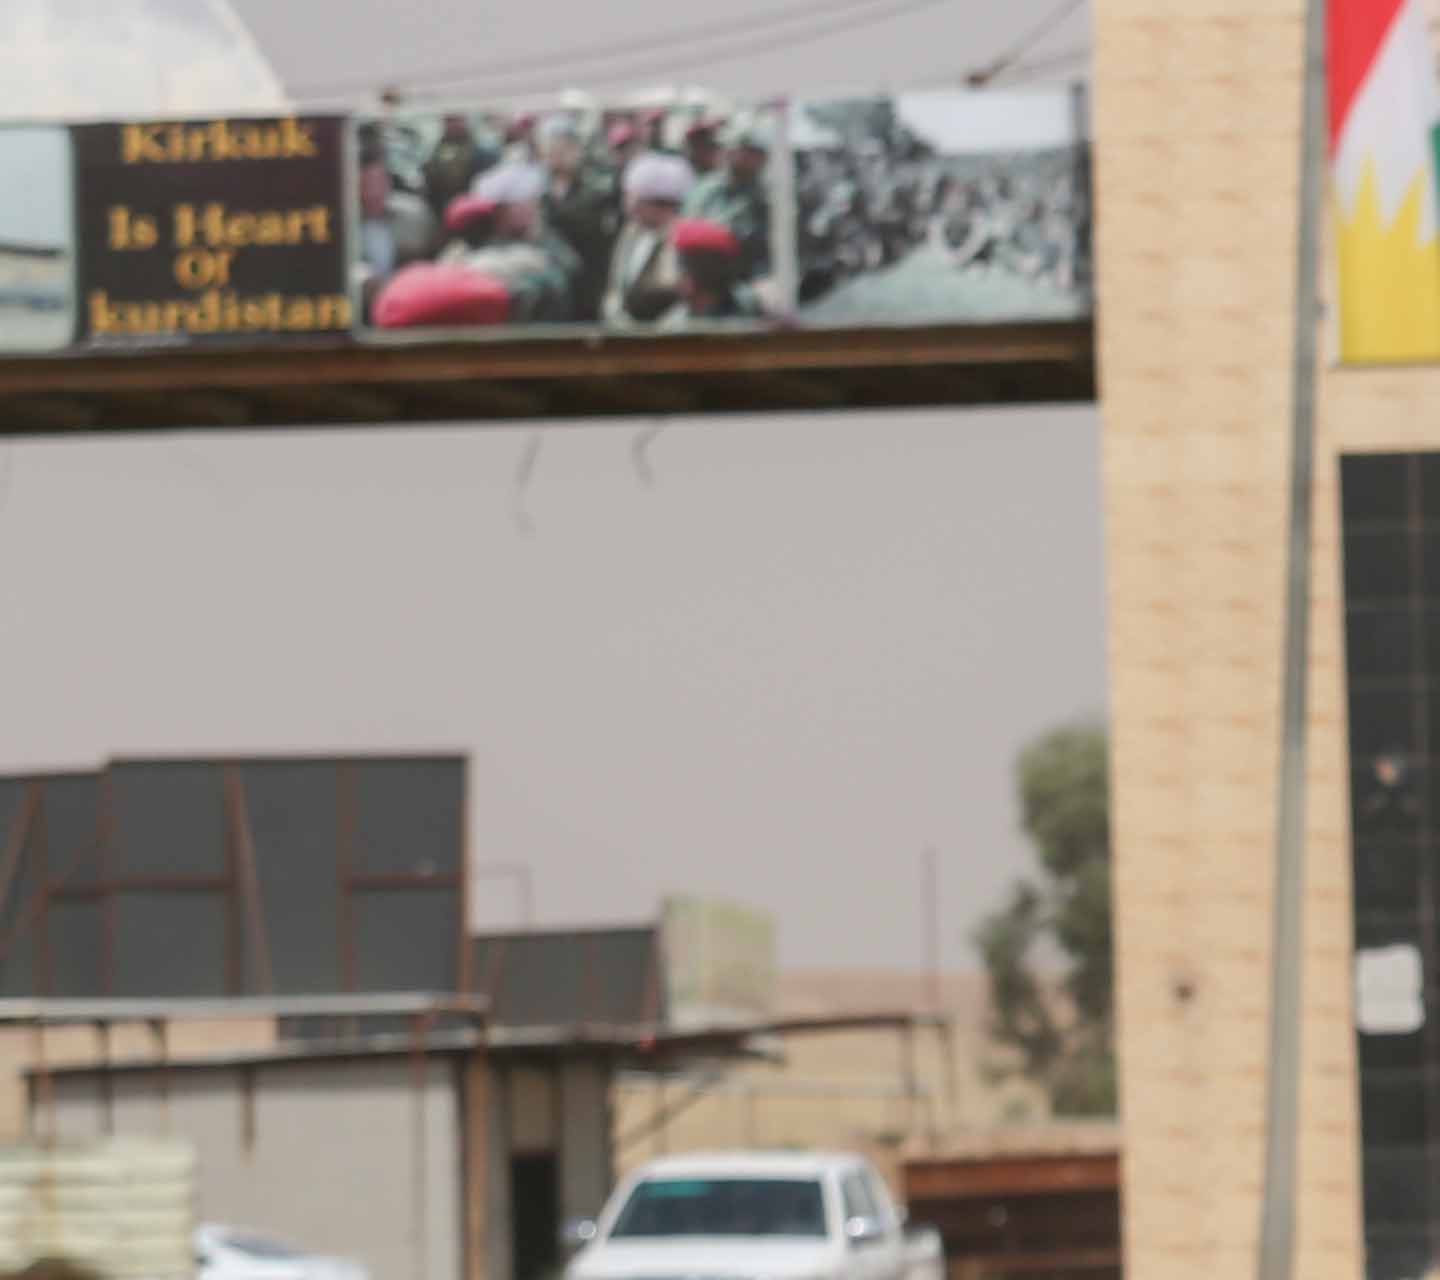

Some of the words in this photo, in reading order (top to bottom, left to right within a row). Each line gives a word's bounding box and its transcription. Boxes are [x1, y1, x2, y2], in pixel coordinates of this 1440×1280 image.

[121, 113, 319, 163] Kirkuk
[174, 203, 331, 247] Heart
[88, 288, 351, 334] kurdistan
